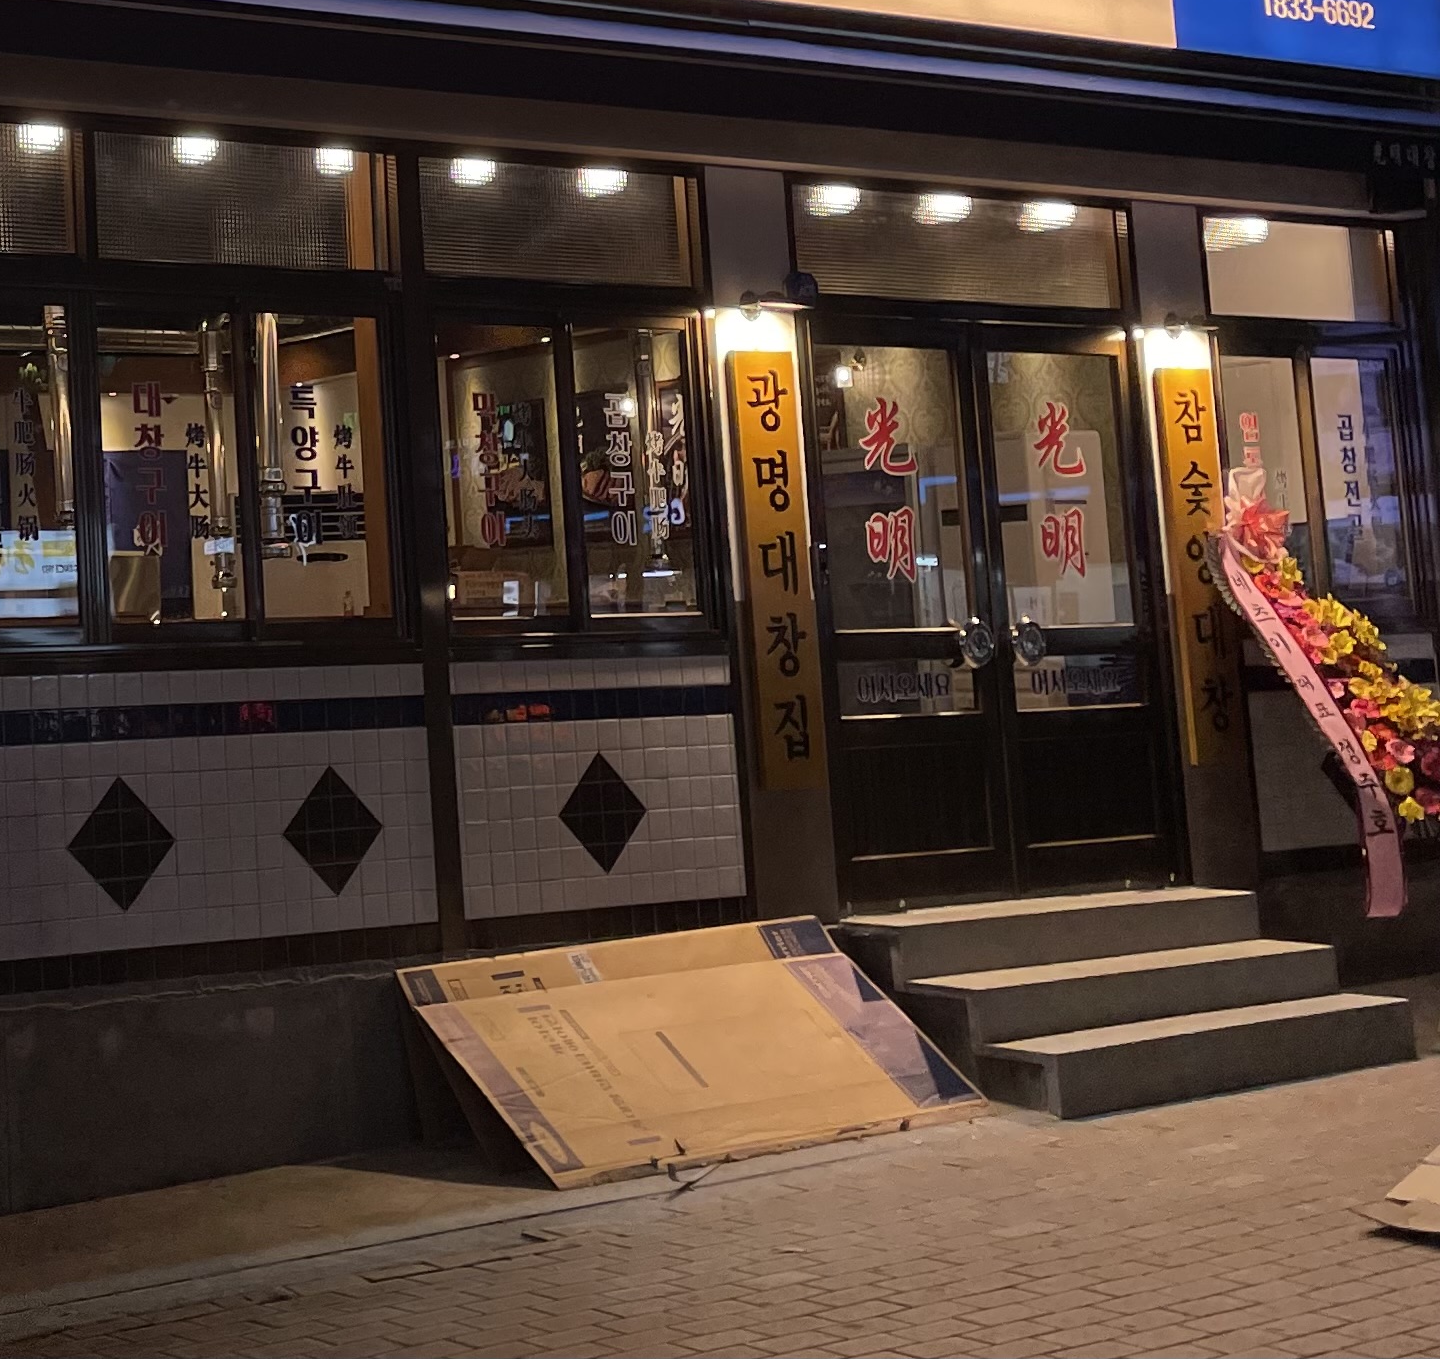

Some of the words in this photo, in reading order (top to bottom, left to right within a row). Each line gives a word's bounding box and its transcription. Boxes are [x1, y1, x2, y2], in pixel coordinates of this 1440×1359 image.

[289, 385, 322, 545] 특양구이
[859, 397, 918, 584] 光明
[1032, 401, 1088, 579] 光明
[746, 368, 810, 761] 광명대창집
